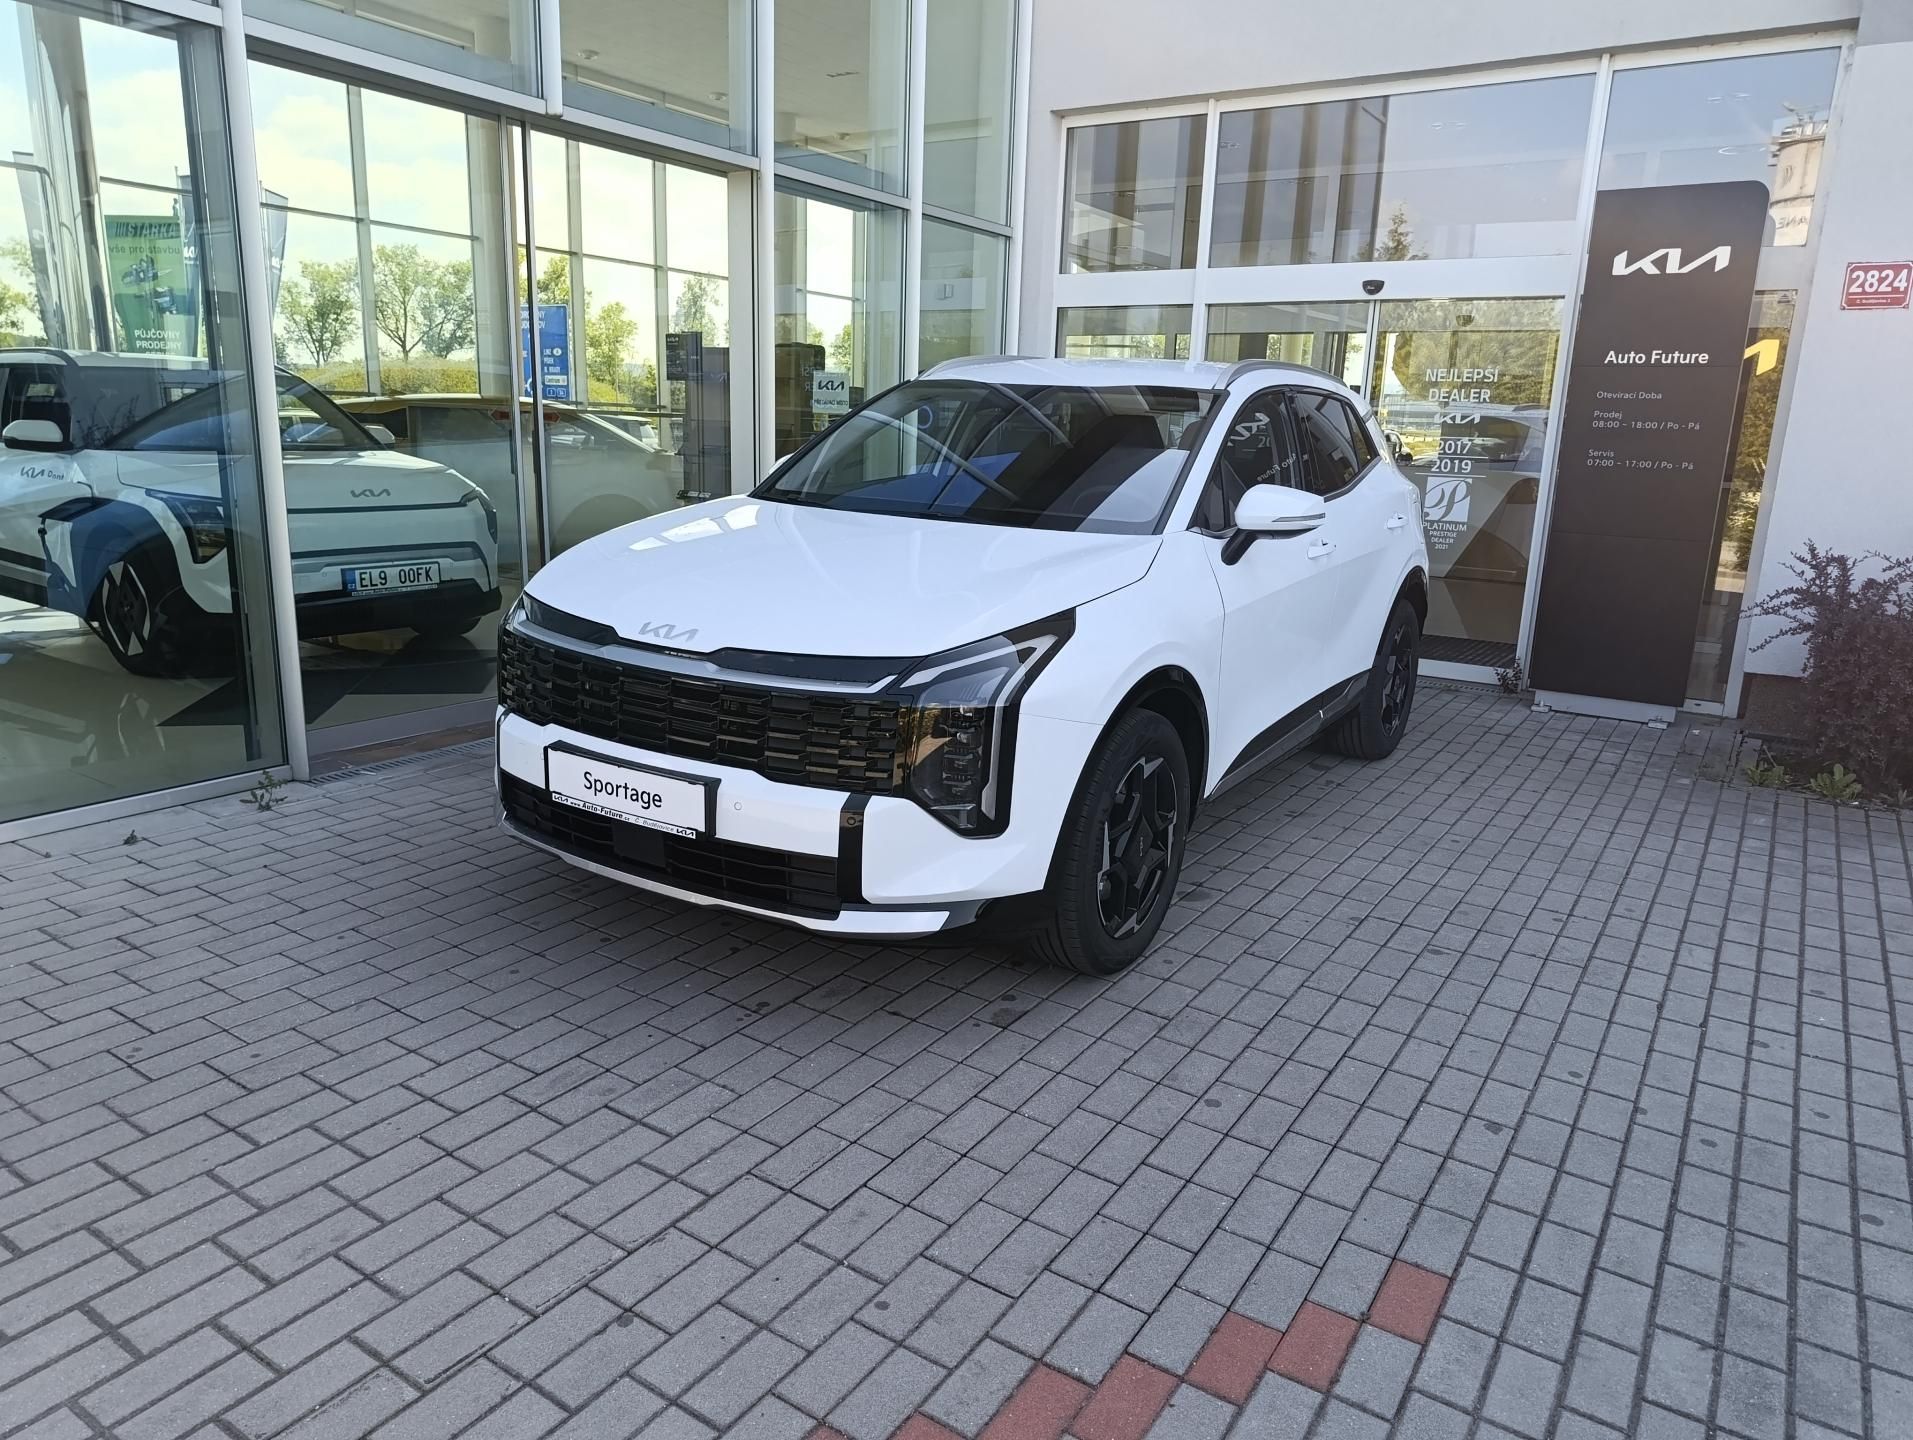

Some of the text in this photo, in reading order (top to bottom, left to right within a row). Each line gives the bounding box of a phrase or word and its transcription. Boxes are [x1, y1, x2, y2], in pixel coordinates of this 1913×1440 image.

[129, 245, 145, 256] pro
[1612, 245, 1731, 276] KIA
[1848, 268, 1908, 293] 2824
[1604, 350, 1709, 364] Auto Future
[1425, 365, 1500, 383] NEJLEPŠÍ
[817, 380, 845, 391] KIA
[1428, 388, 1491, 402] DEALER
[1638, 391, 1662, 400] Doba
[1434, 412, 1481, 424] KIA
[1593, 410, 1623, 420] Prodej
[1592, 420, 1620, 429] 08:00
[1631, 421, 1659, 429] 18:00
[1667, 422, 1680, 430] Po
[1687, 422, 1700, 430] Pá
[1438, 440, 1472, 454] 2017
[1588, 449, 1615, 458] Servis
[1430, 458, 1472, 473] 2019
[1586, 458, 1614, 467] 07:00
[1625, 460, 1653, 469] 17:00
[1660, 461, 1673, 469] Po
[1681, 462, 1694, 470] Pá
[20, 466, 45, 479] KIA
[350, 488, 391, 498] KIA
[1421, 521, 1467, 532] PLATINUM
[1429, 530, 1458, 538] PRESTIGE
[1430, 536, 1455, 544] DEALER
[359, 569, 388, 589] EL9
[638, 621, 699, 642] KIA
[583, 770, 663, 810] Sportage
[553, 794, 569, 803] KIA
[676, 827, 695, 838] KIA
